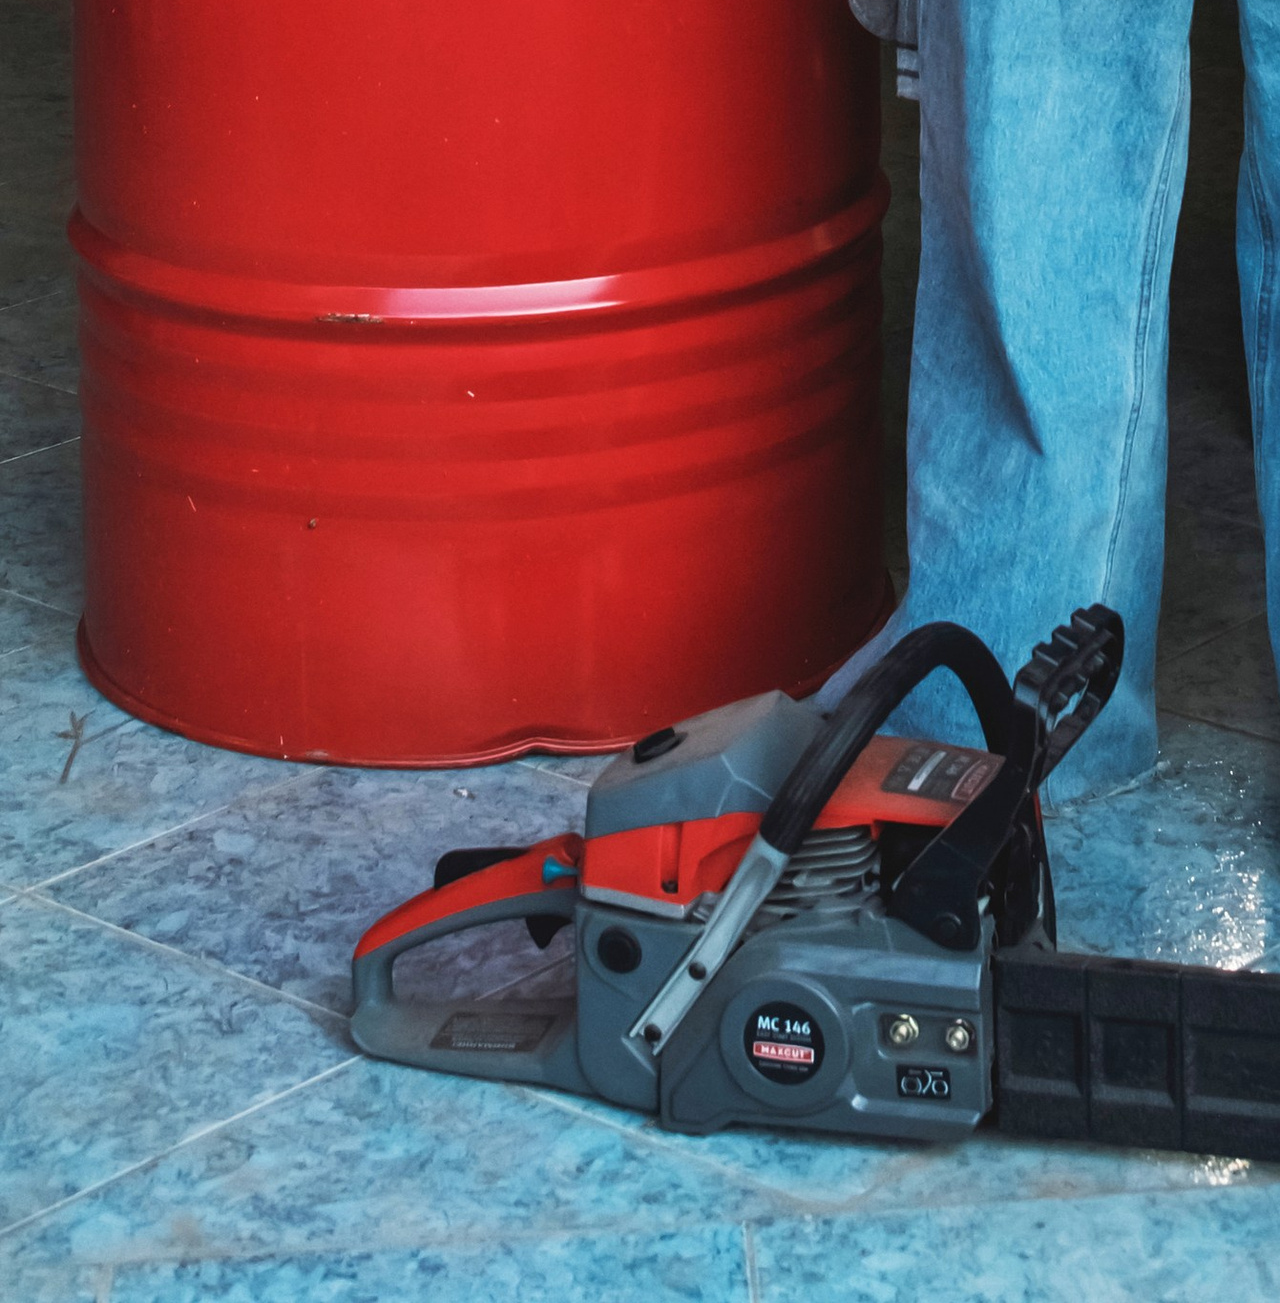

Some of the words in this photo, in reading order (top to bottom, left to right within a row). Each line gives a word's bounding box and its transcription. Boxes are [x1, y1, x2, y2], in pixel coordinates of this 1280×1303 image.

[757, 1015, 780, 1032] MC
[784, 1019, 811, 1035] 146
[761, 1044, 805, 1059] MAXCUT
